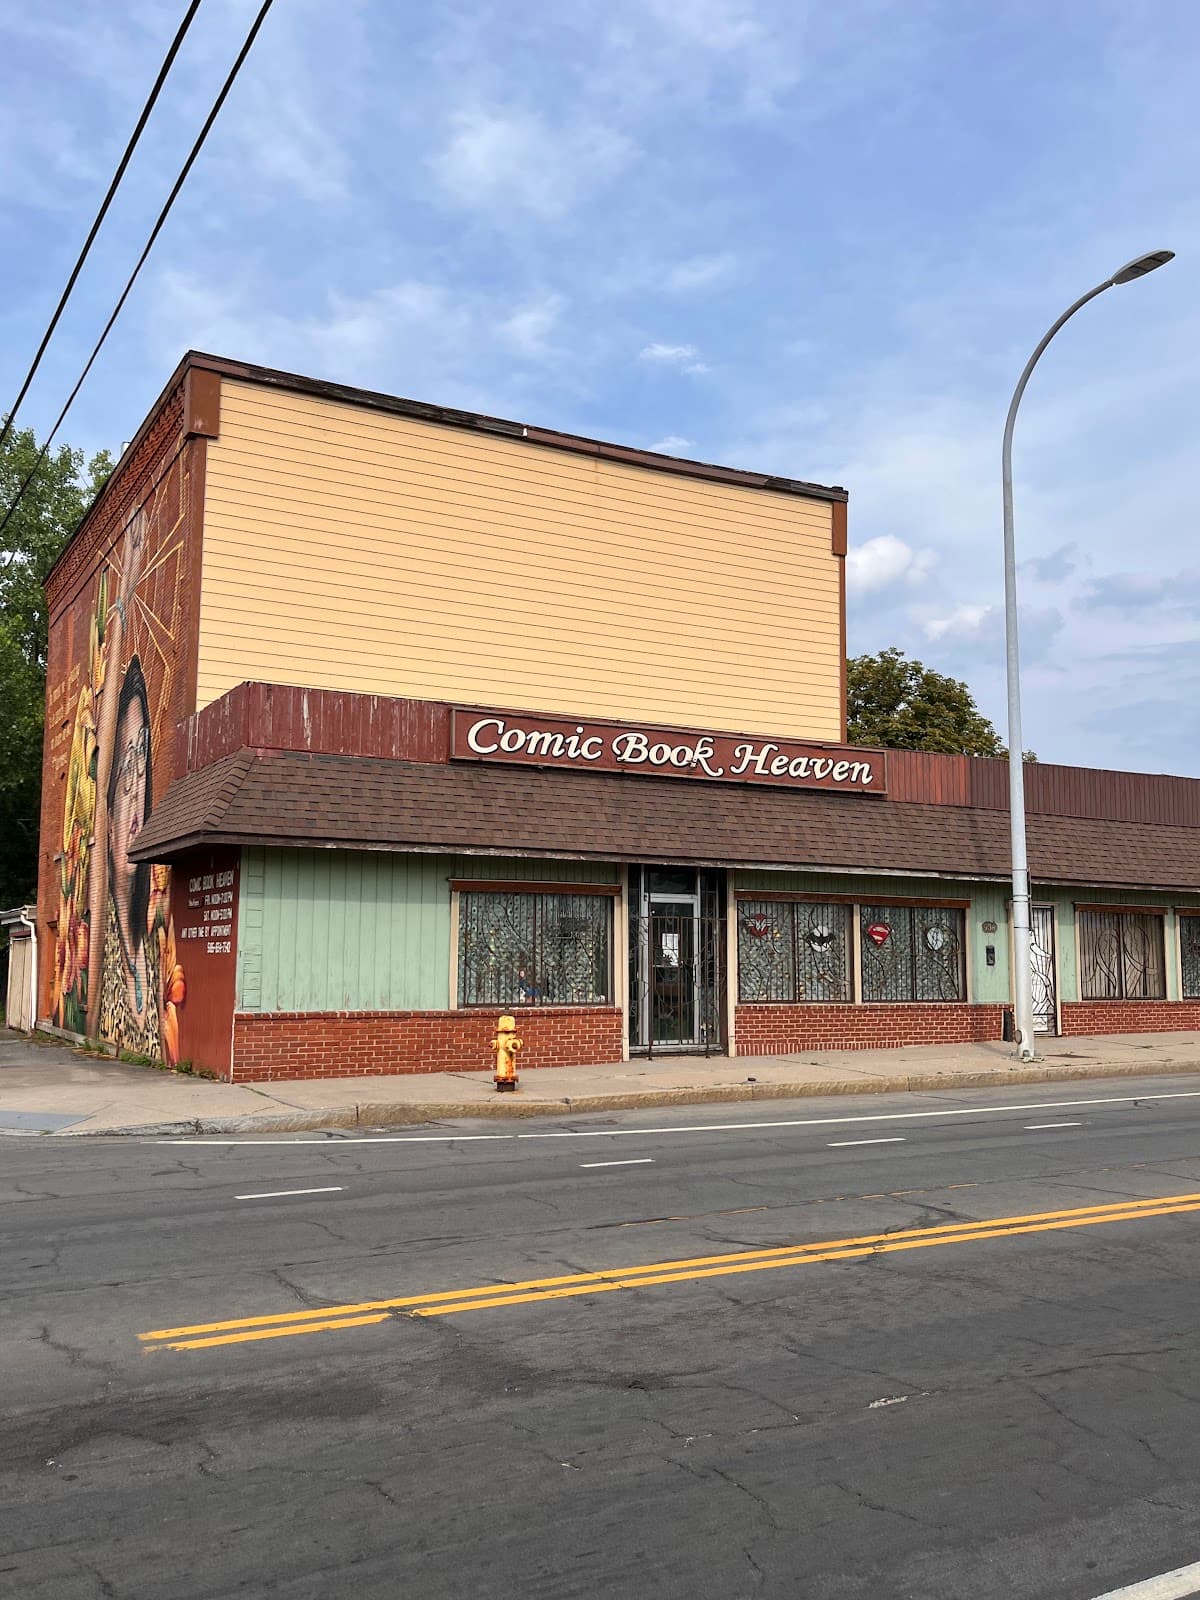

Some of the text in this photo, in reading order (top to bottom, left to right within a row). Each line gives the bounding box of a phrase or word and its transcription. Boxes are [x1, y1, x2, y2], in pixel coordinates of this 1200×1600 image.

[467, 718, 873, 785] Comic Book Heaven
[215, 870, 233, 888] HEAVEN
